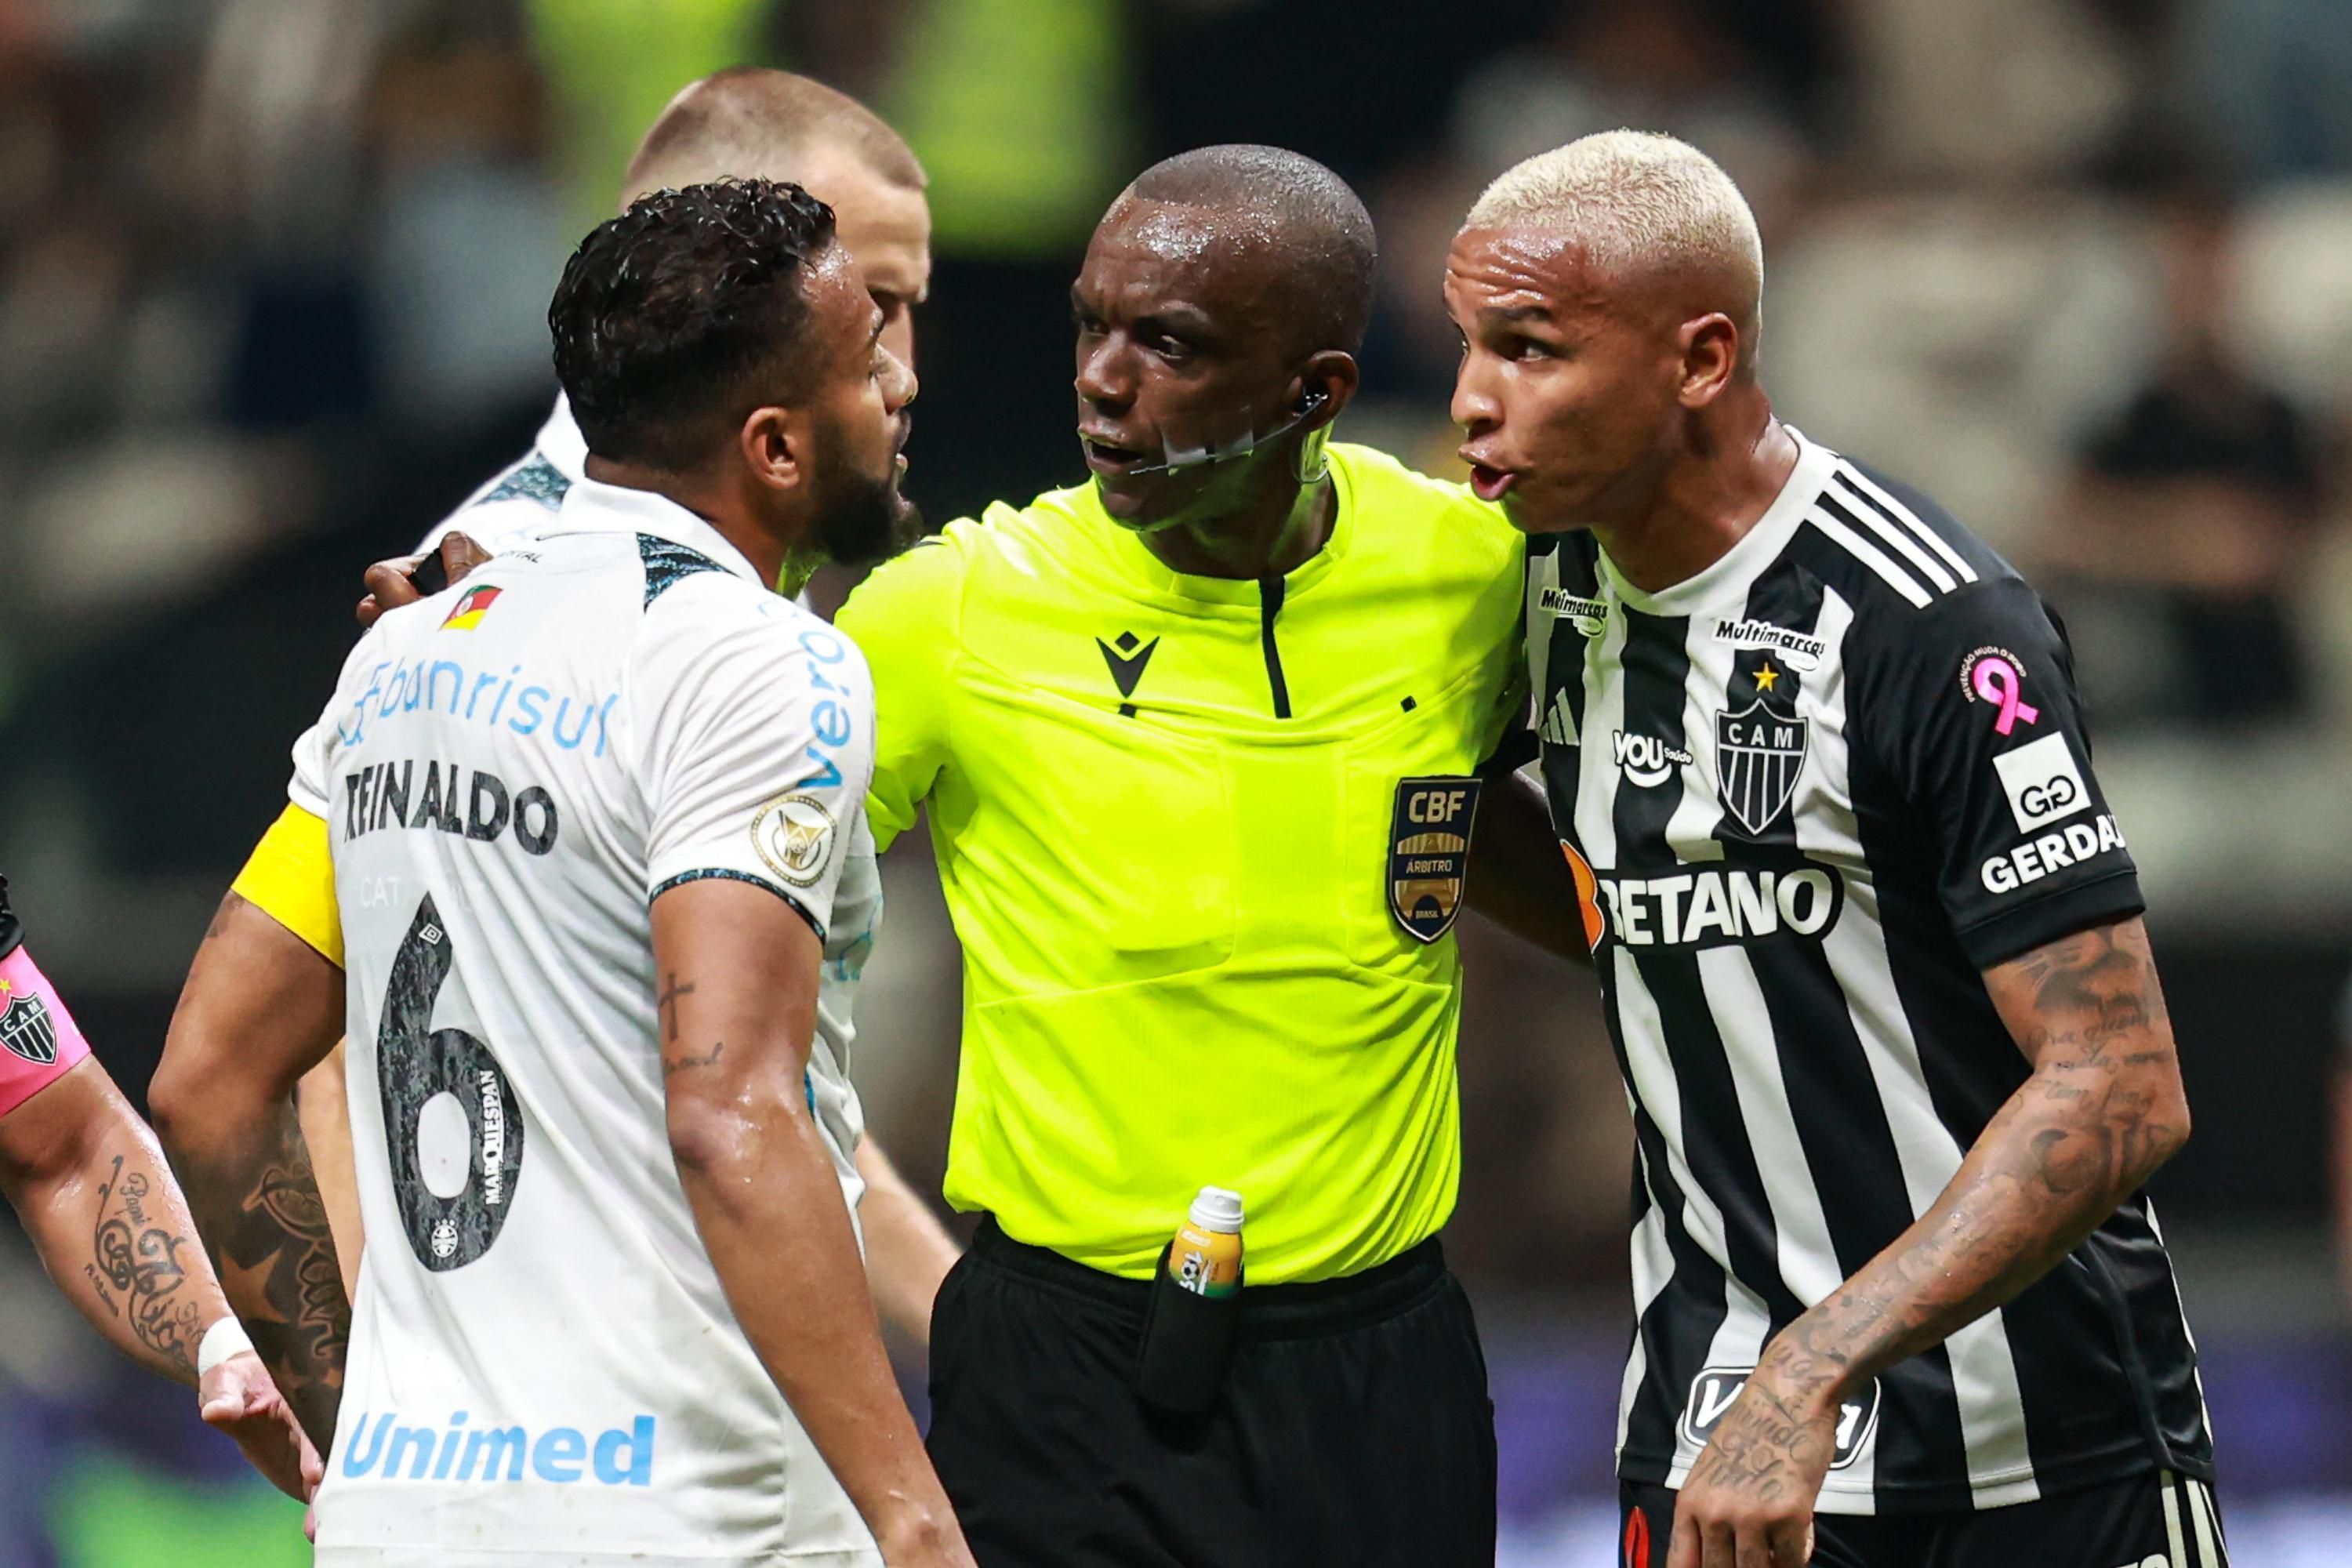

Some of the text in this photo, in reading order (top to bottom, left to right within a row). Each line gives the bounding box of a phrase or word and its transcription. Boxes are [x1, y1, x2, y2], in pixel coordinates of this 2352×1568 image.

[1715, 620, 1825, 655] Multimarcas
[379, 657, 620, 758] banrisul
[797, 630, 851, 788] vero
[1613, 731, 1664, 770] YOU
[1728, 722, 1794, 749] CAM
[1409, 790, 1466, 823] CBF
[1406, 858, 1453, 875] ÁRBITRO
[3, 1000, 41, 1033] CAM
[377, 891, 524, 1273] 6
[480, 1069, 504, 1205] MARQUESPAN
[343, 1410, 656, 1486] Unimed
